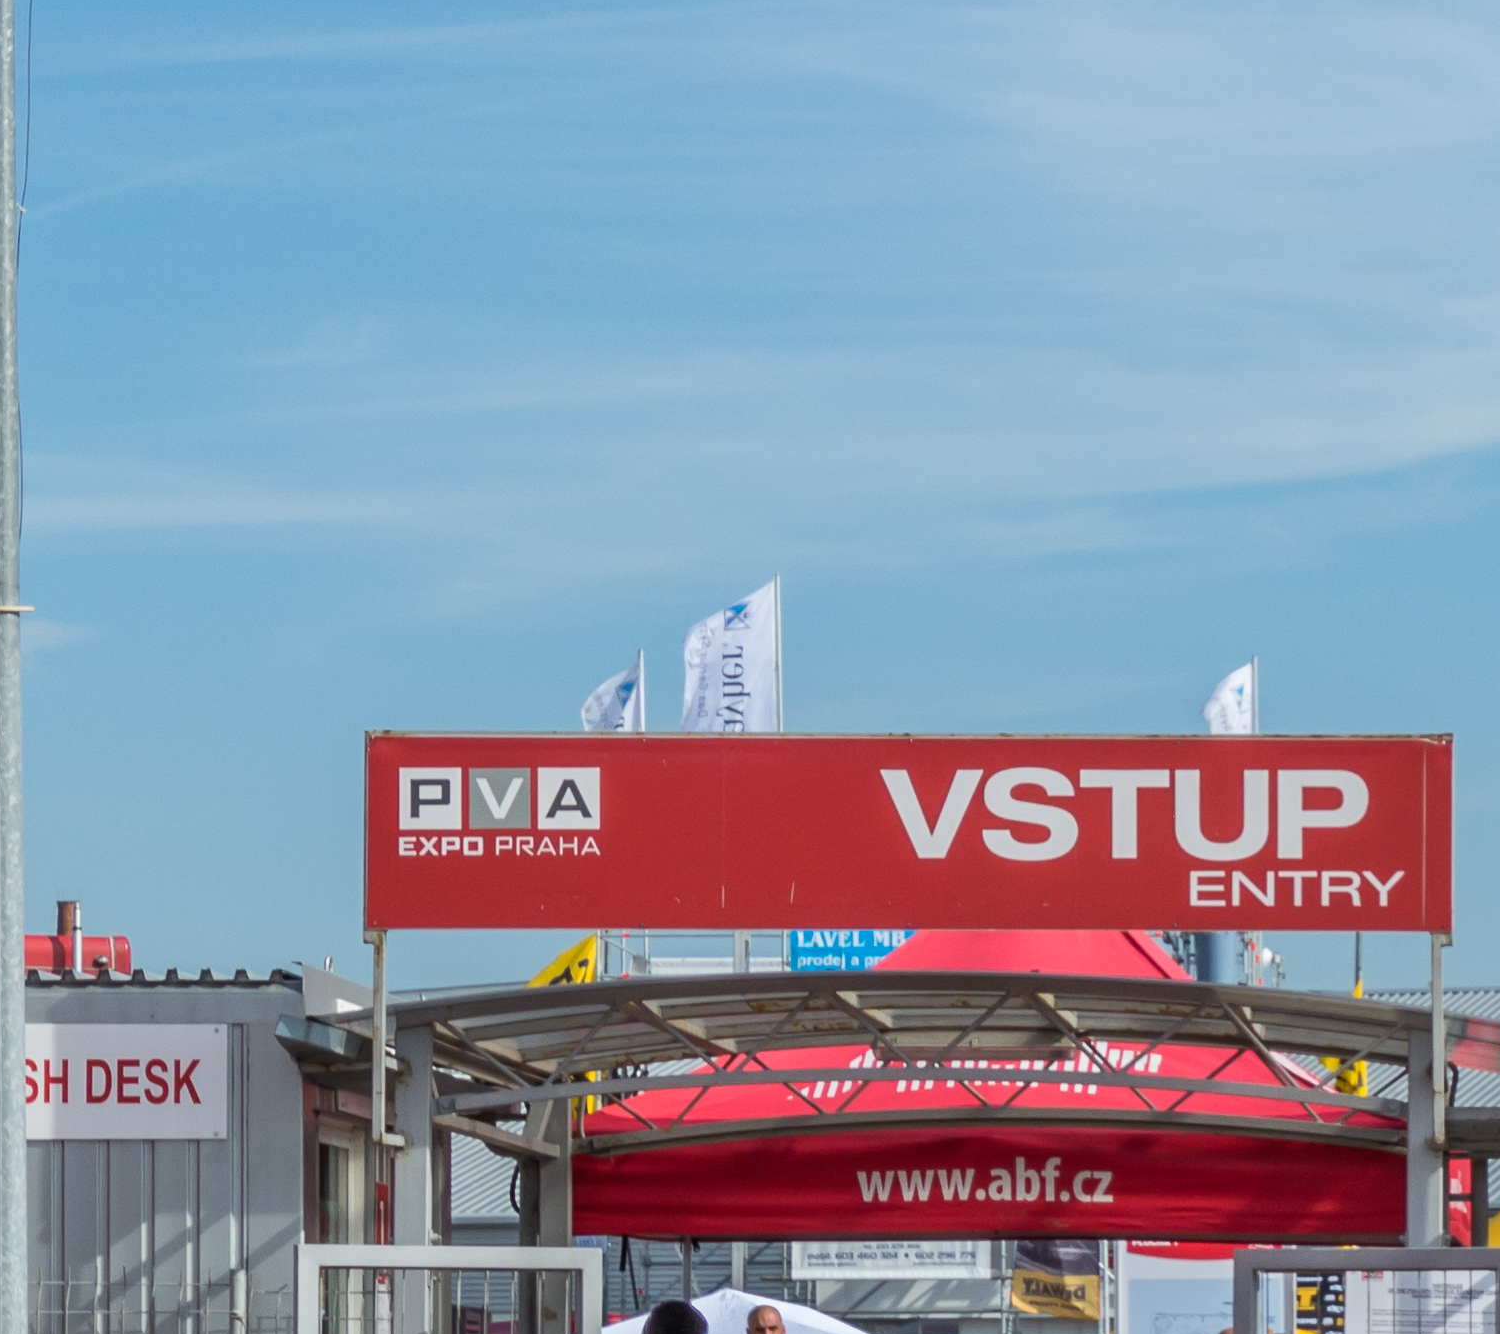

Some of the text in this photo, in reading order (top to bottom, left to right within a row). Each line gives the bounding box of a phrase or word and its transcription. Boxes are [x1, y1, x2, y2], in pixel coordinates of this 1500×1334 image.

[410, 767, 1370, 862] PVA VSTUP
[398, 837, 1405, 907] EXPO PRAHA ENTRY
[797, 931, 865, 948] LAVEL
[797, 954, 860, 970] prodej a
[85, 1057, 202, 1106] DESK
[856, 1156, 1114, 1203] www.abf.cz
